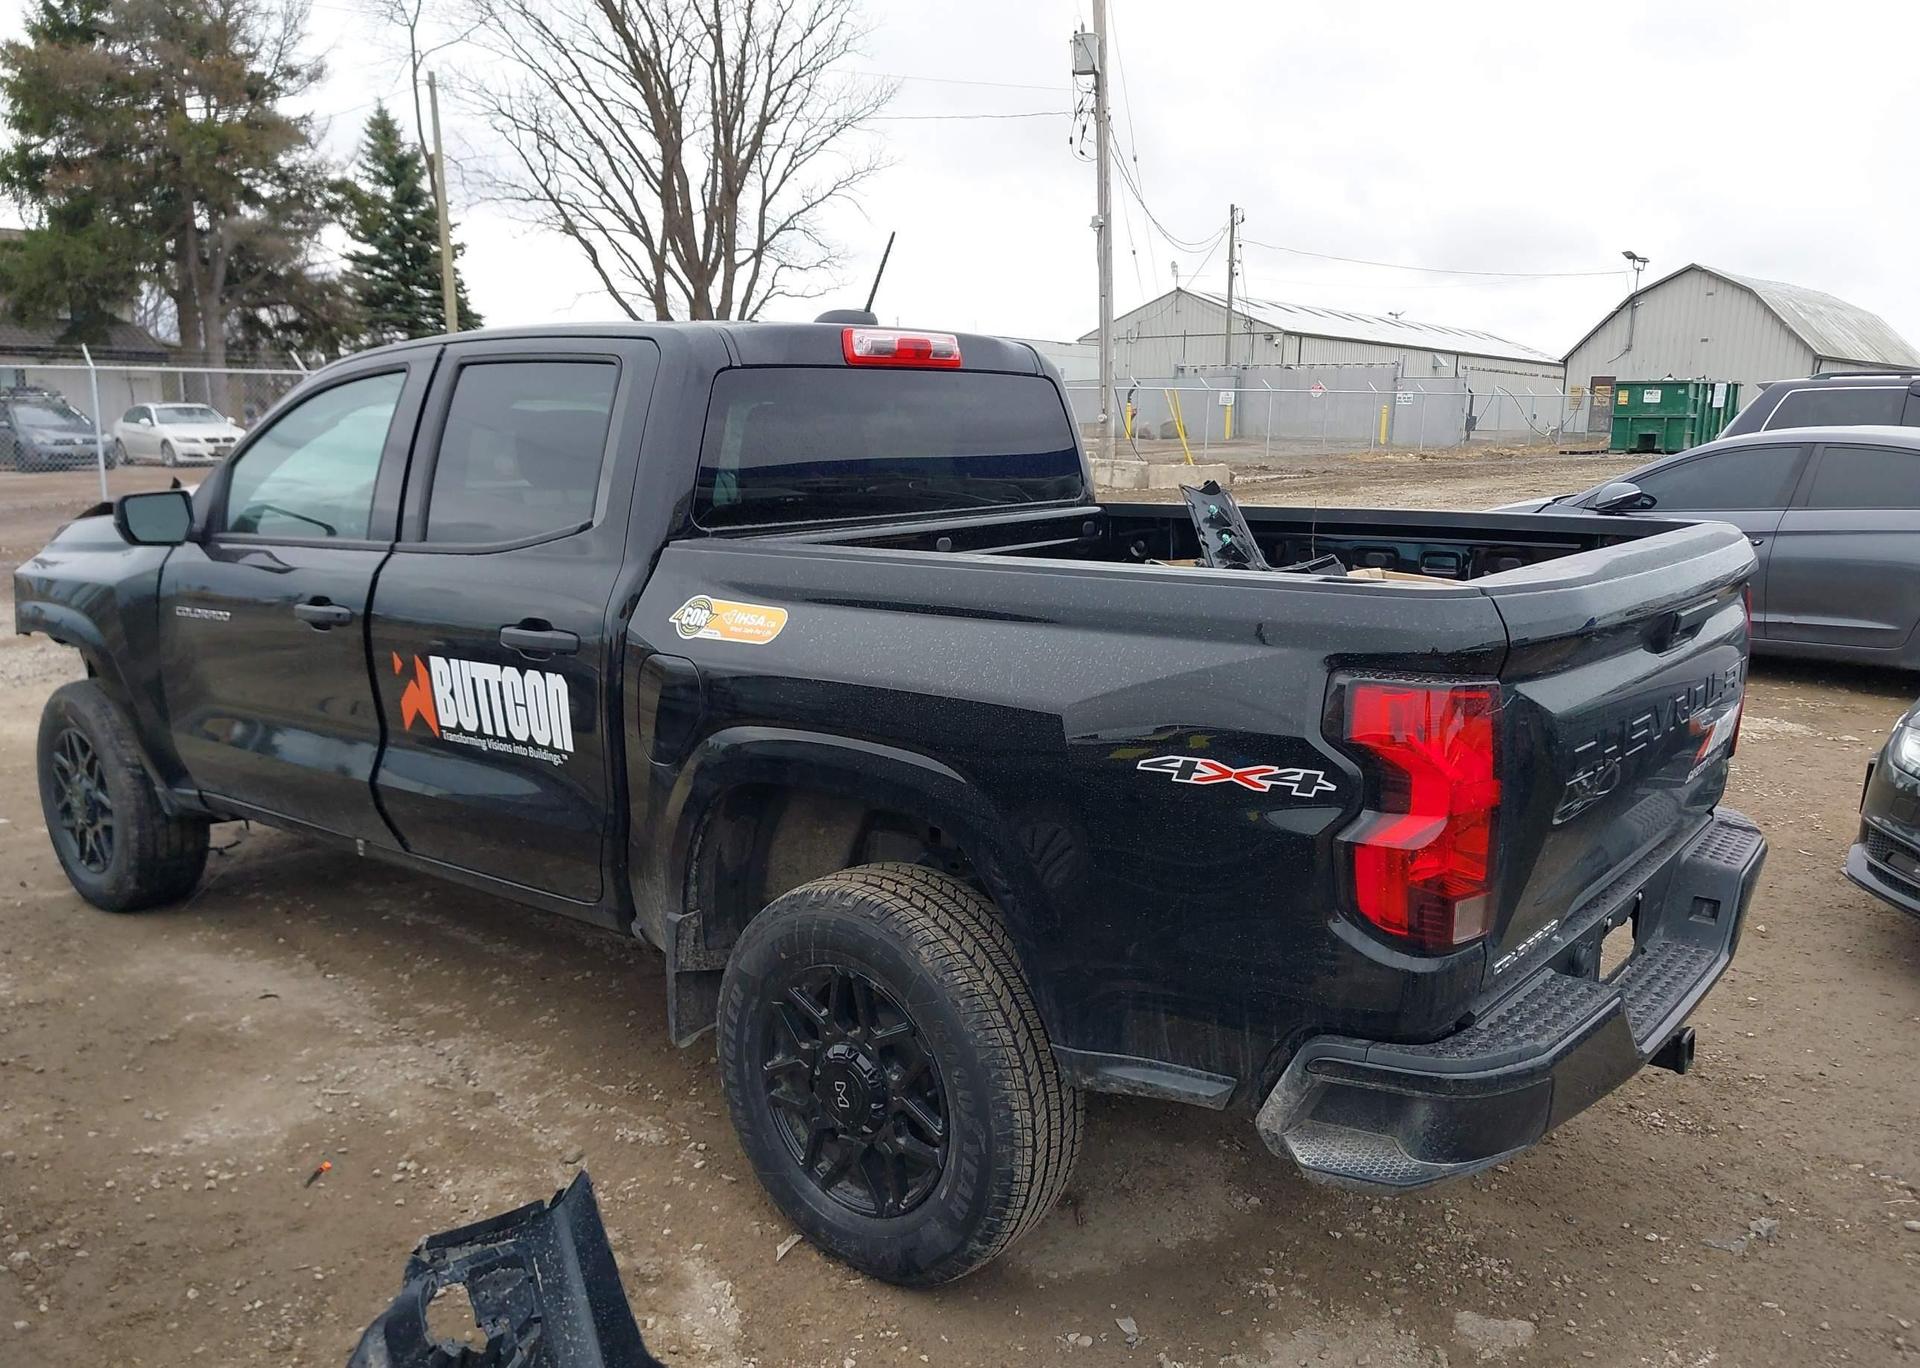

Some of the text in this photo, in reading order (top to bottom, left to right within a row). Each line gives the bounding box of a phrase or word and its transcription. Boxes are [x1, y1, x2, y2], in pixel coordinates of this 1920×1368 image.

[428, 655, 575, 752] BUTTCON
[441, 729, 488, 751] Transforming
[486, 738, 513, 753] Visions
[512, 743, 529, 757] into
